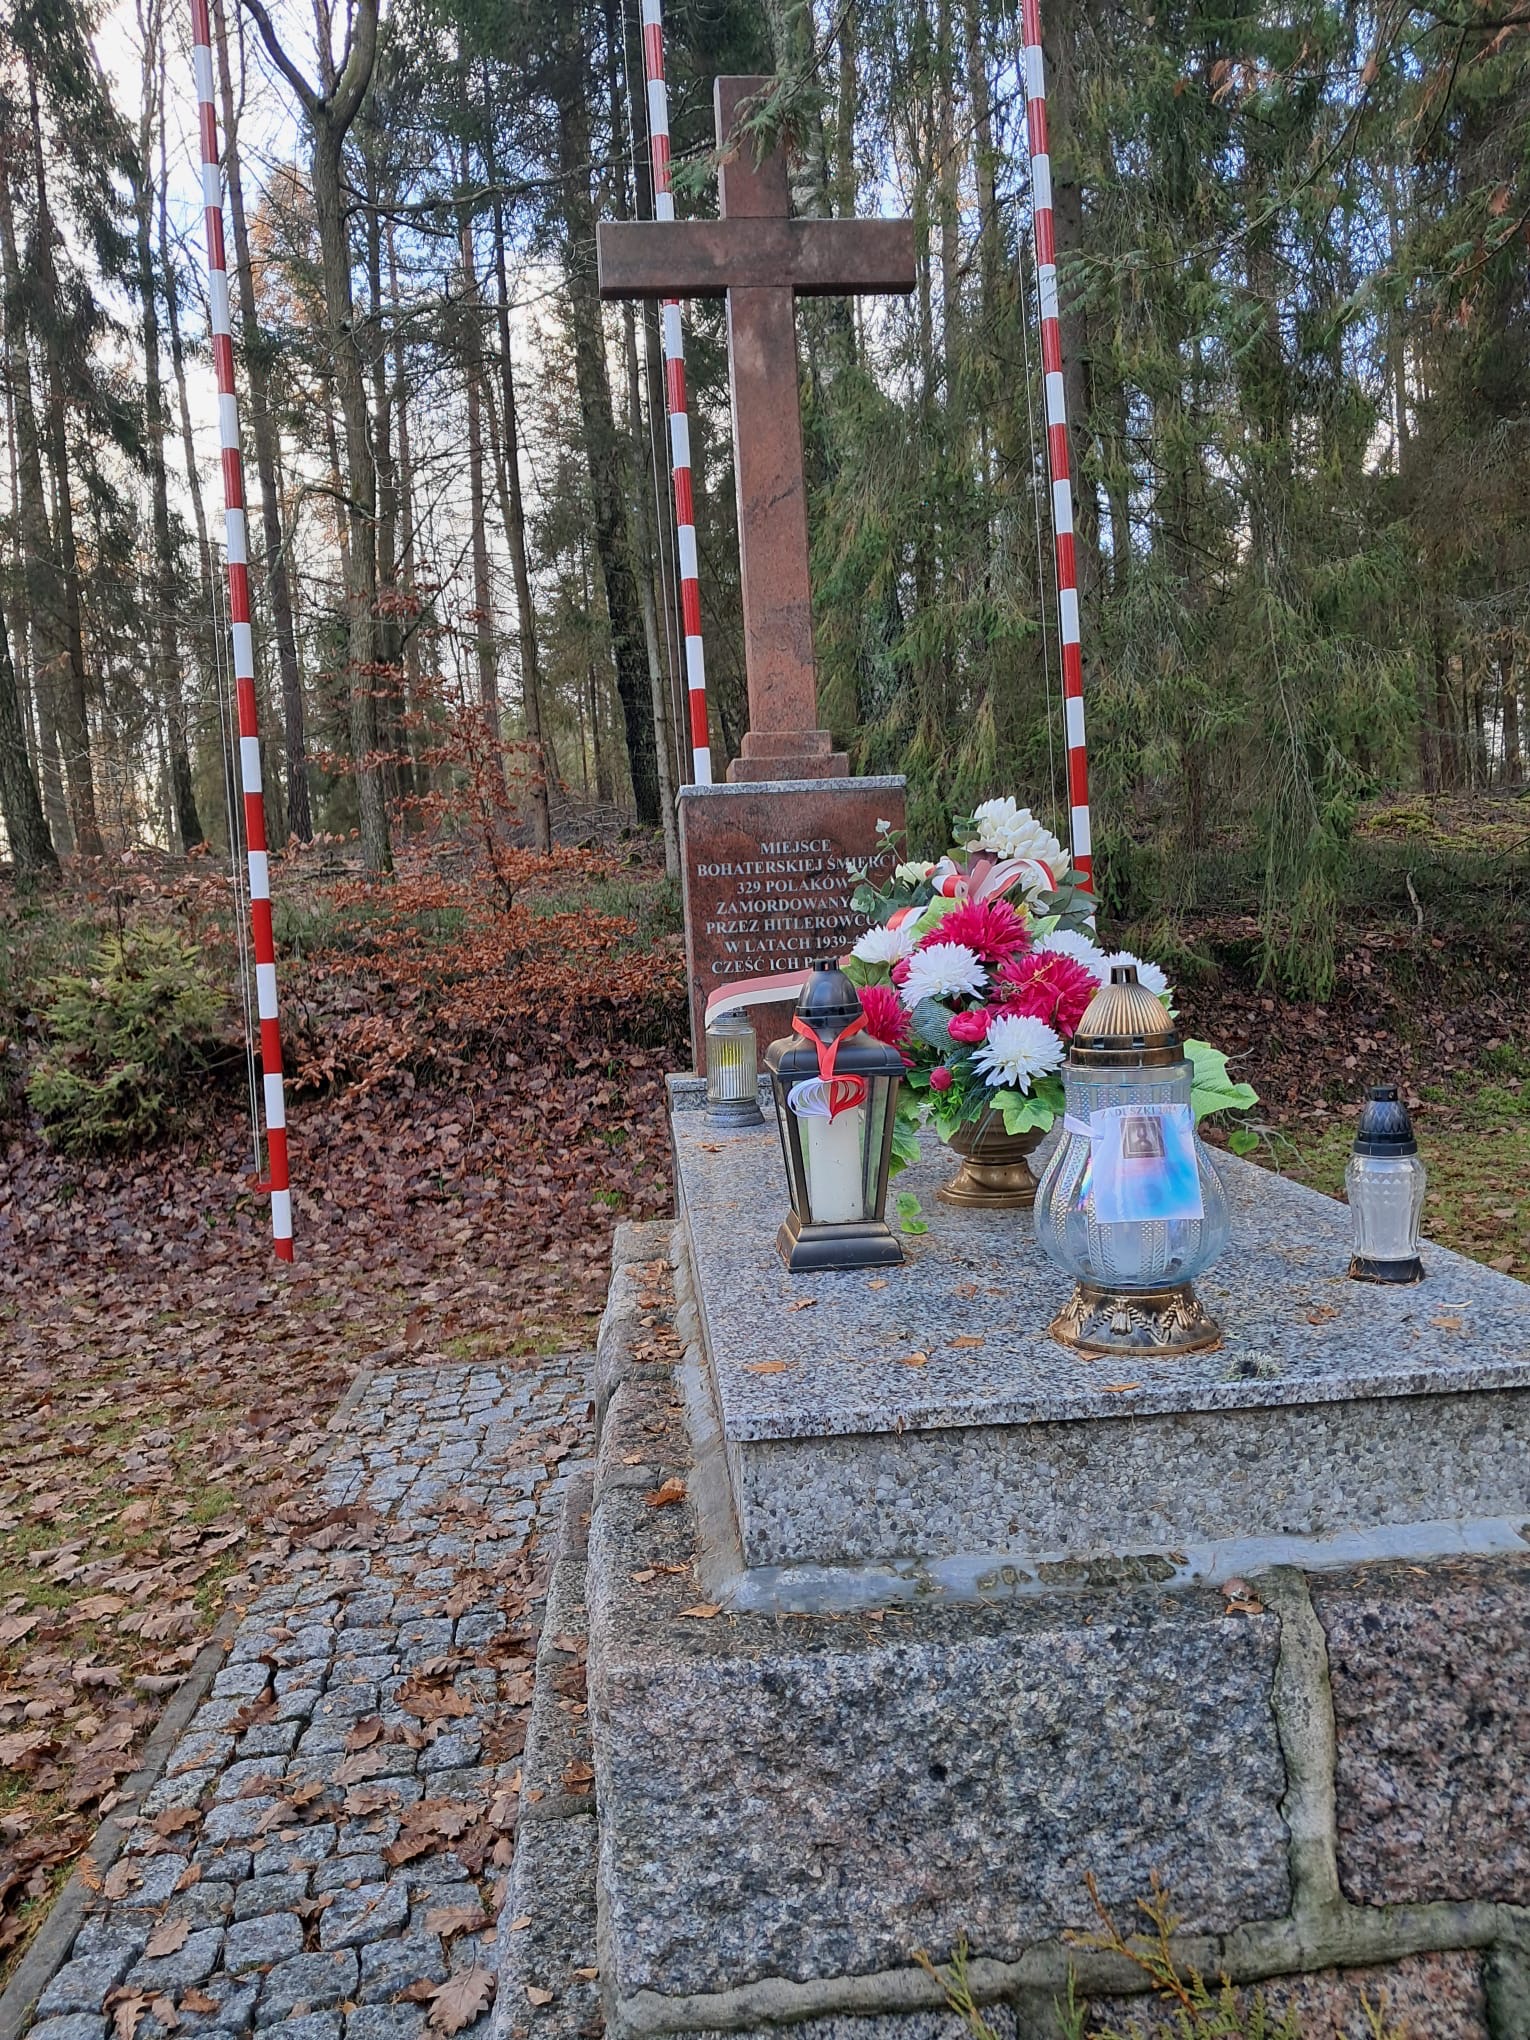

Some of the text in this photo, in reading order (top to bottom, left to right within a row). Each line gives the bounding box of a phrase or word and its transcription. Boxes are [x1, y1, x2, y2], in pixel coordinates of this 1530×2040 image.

[760, 839, 831, 855] MIEJSCE
[697, 858, 822, 877] BOHATERSKIEJ
[737, 874, 848, 895] 329 POLAKÓW
[716, 896, 851, 915] ZAMORDOWANY
[706, 914, 878, 935] PRZEZ HITLEROWC
[724, 934, 862, 953] W LATACH 1939-
[711, 956, 766, 974] CZEŚĆ
[769, 957, 799, 971] ICH
